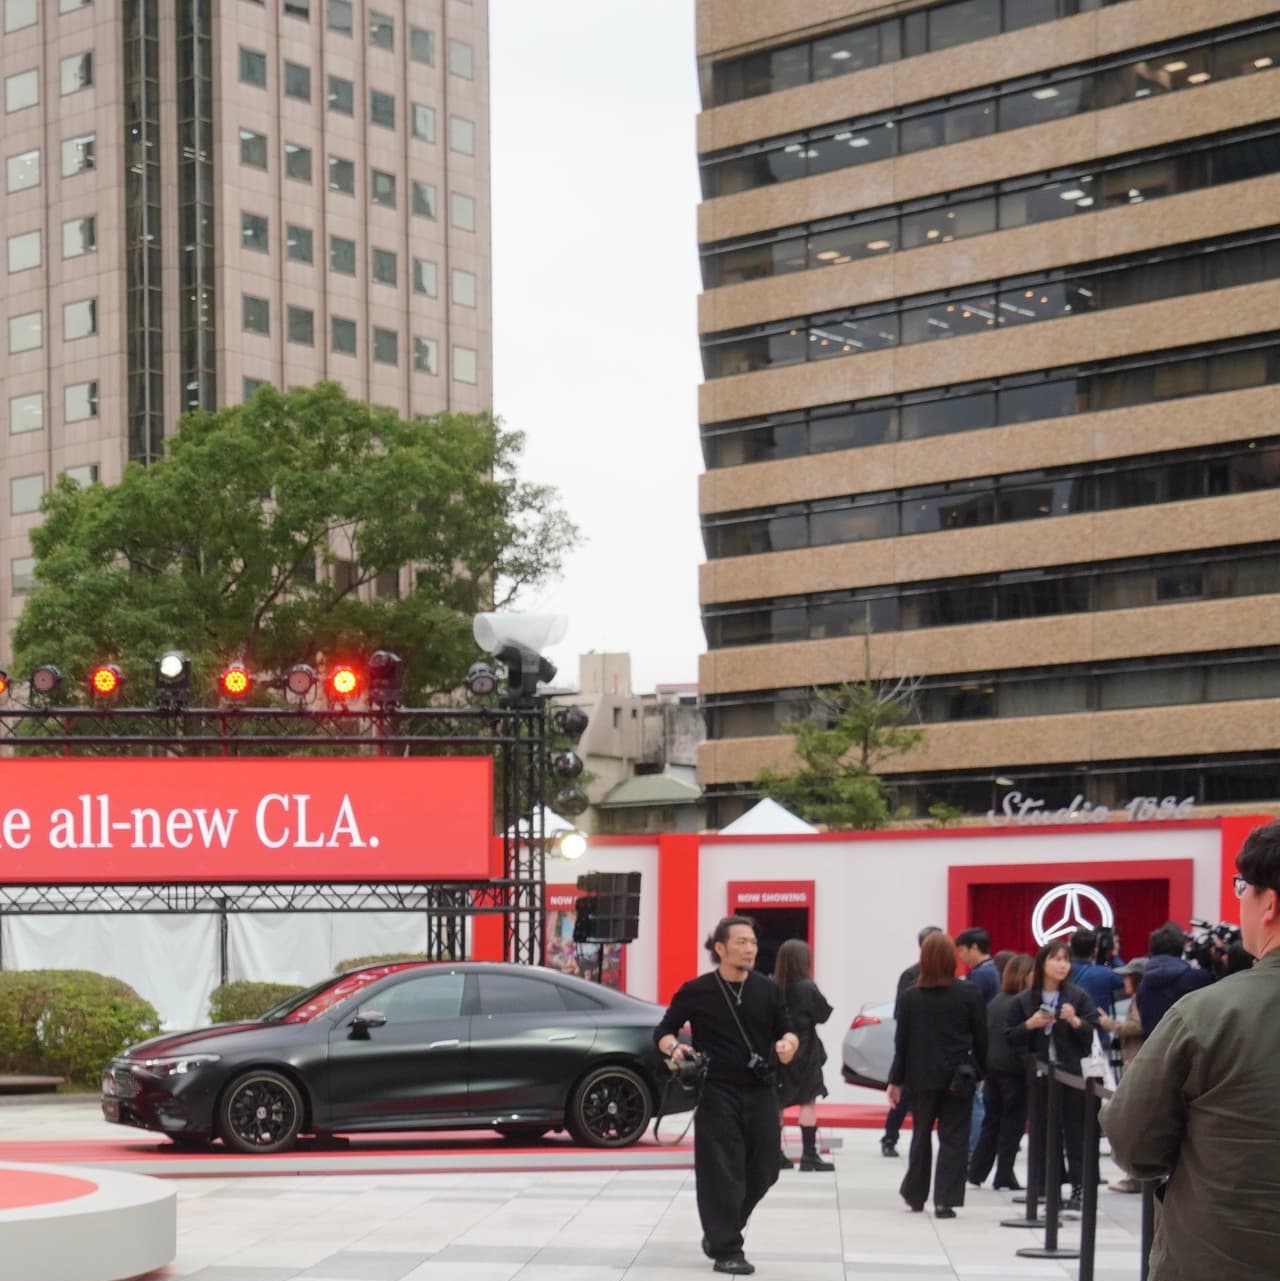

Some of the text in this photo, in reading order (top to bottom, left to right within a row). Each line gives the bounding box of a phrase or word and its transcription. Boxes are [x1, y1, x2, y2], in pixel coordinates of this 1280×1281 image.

[987, 791, 1195, 826] Studio 1886
[49, 793, 239, 849] all-new
[255, 793, 380, 849] CLA.
[550, 895, 573, 905] NOW
[737, 892, 807, 903] NOW SHOWING
